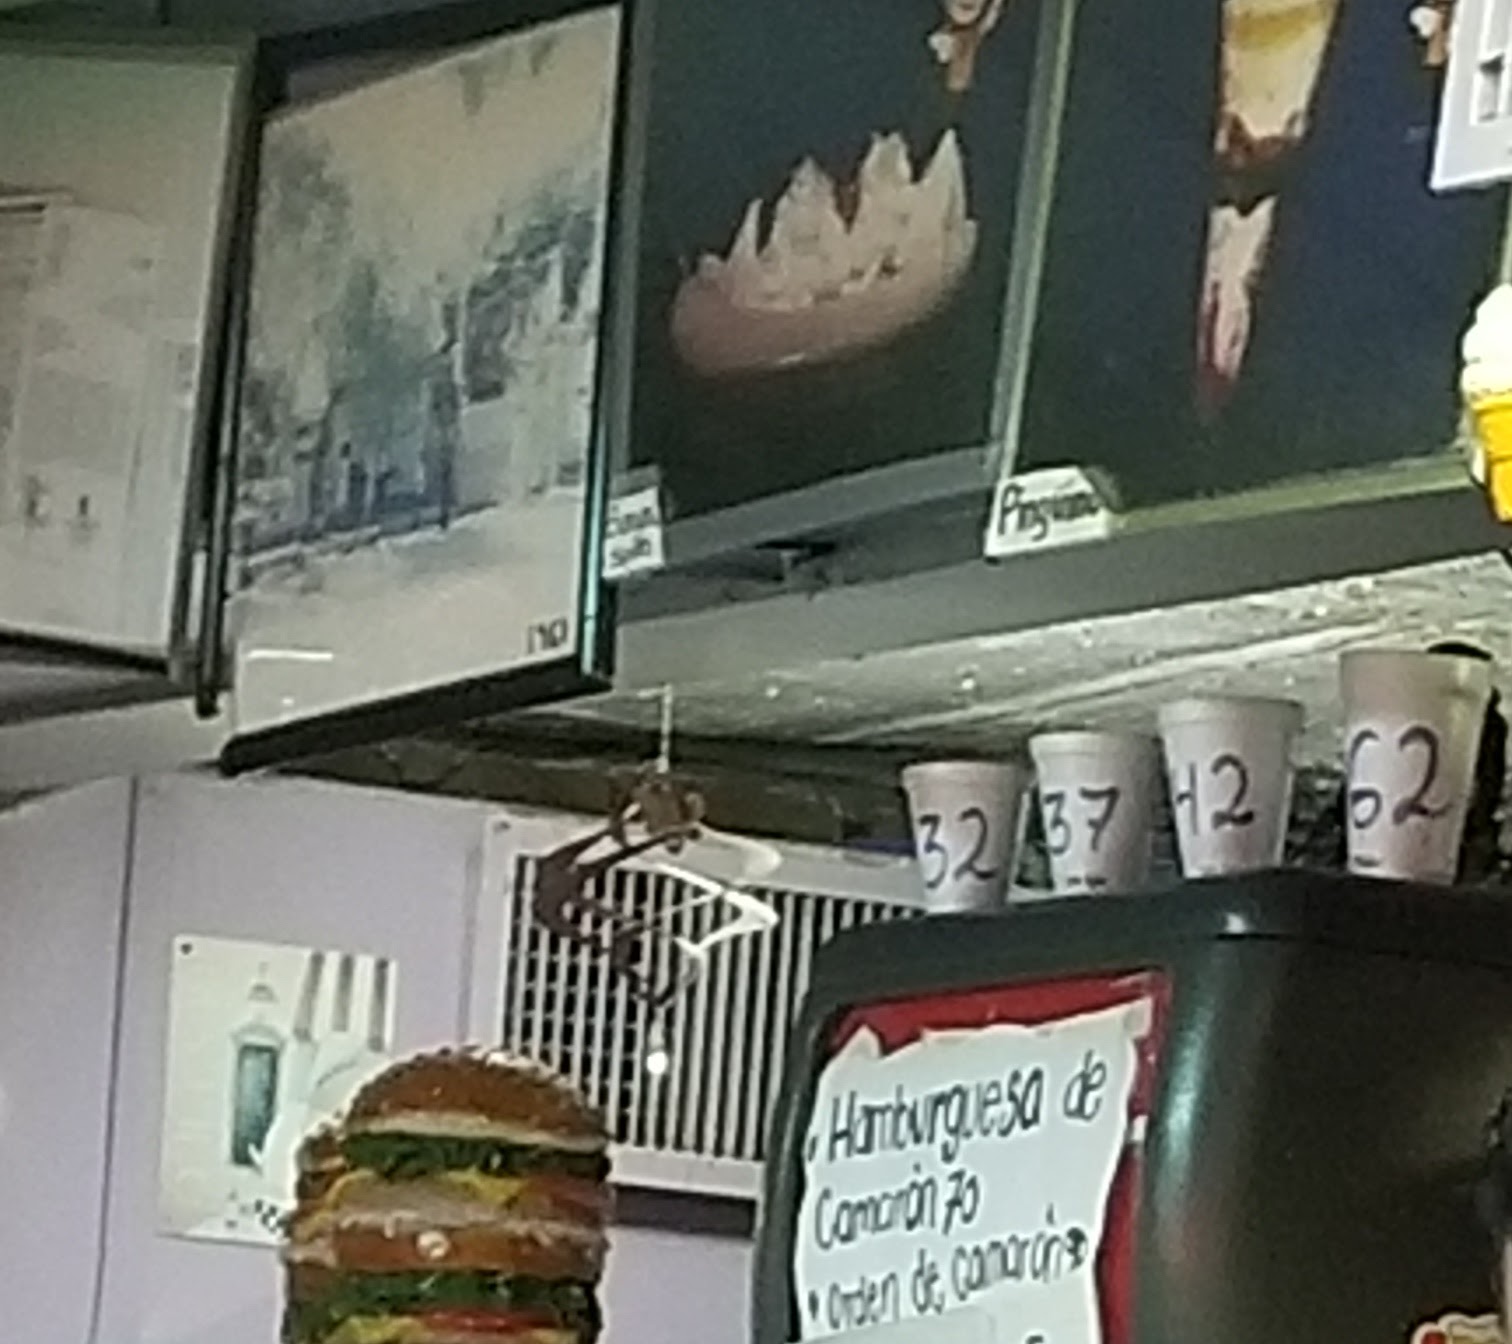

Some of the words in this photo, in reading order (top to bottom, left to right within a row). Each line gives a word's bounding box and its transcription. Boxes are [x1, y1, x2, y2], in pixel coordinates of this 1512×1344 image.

[918, 806, 1001, 890] 32
[1043, 786, 1120, 856] 37
[828, 1067, 1044, 1165] Hamburguesa
[1063, 1050, 1107, 1121] de
[941, 1168, 980, 1235] 70
[912, 1248, 946, 1315] de
